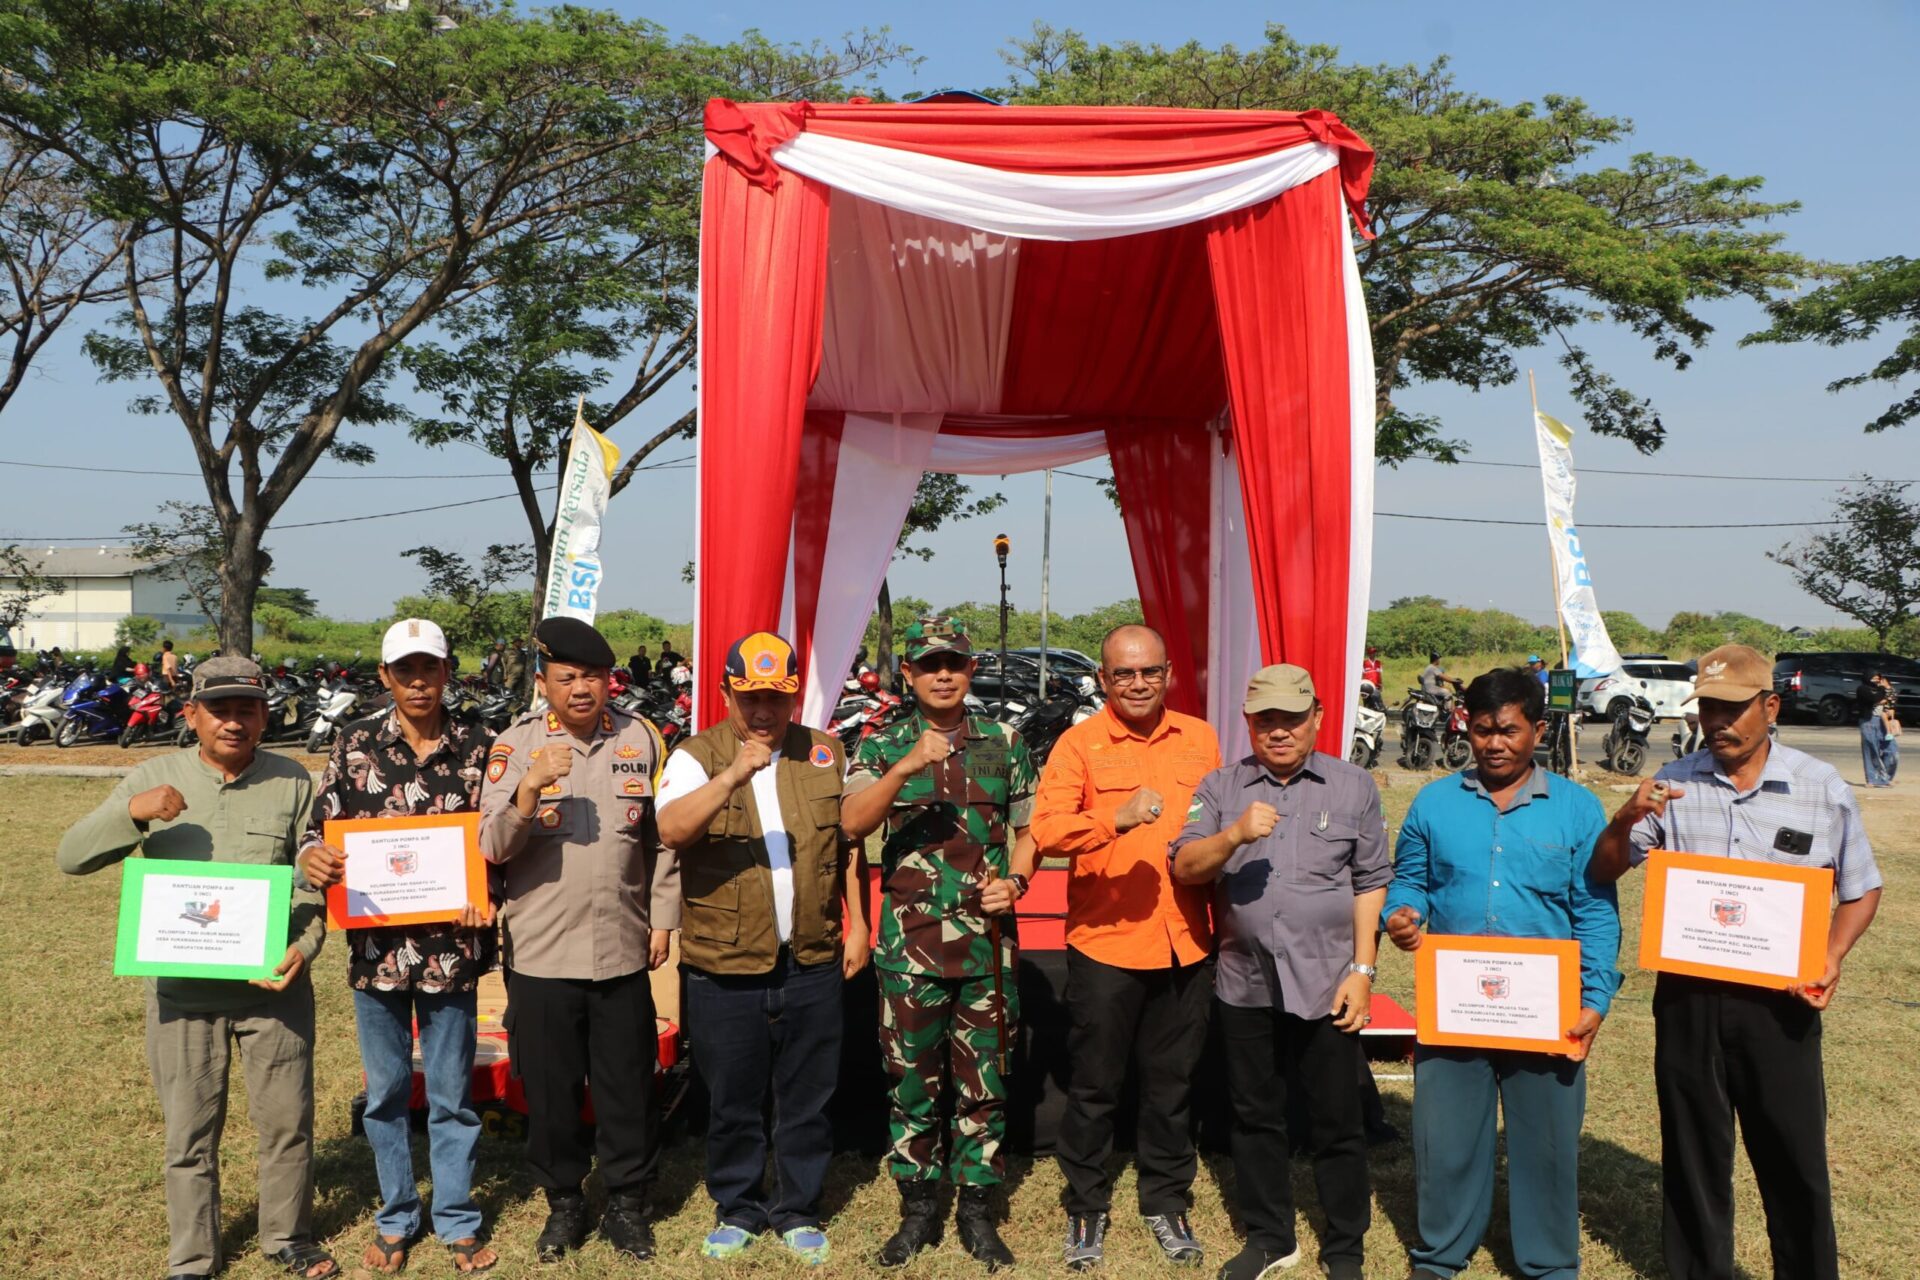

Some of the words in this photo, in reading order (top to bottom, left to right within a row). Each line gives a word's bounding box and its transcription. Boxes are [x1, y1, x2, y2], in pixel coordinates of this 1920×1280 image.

[560, 450, 589, 525] Persada
[567, 560, 600, 610] BSI
[733, 677, 798, 690] BPBD
[612, 763, 647, 774] POLRI
[1697, 879, 1727, 887] BANTUAN
[1684, 927, 1713, 935] KELOMPOK
[1698, 945, 1730, 953] KABUPATEN
[1742, 943, 1771, 951] SUKATANI
